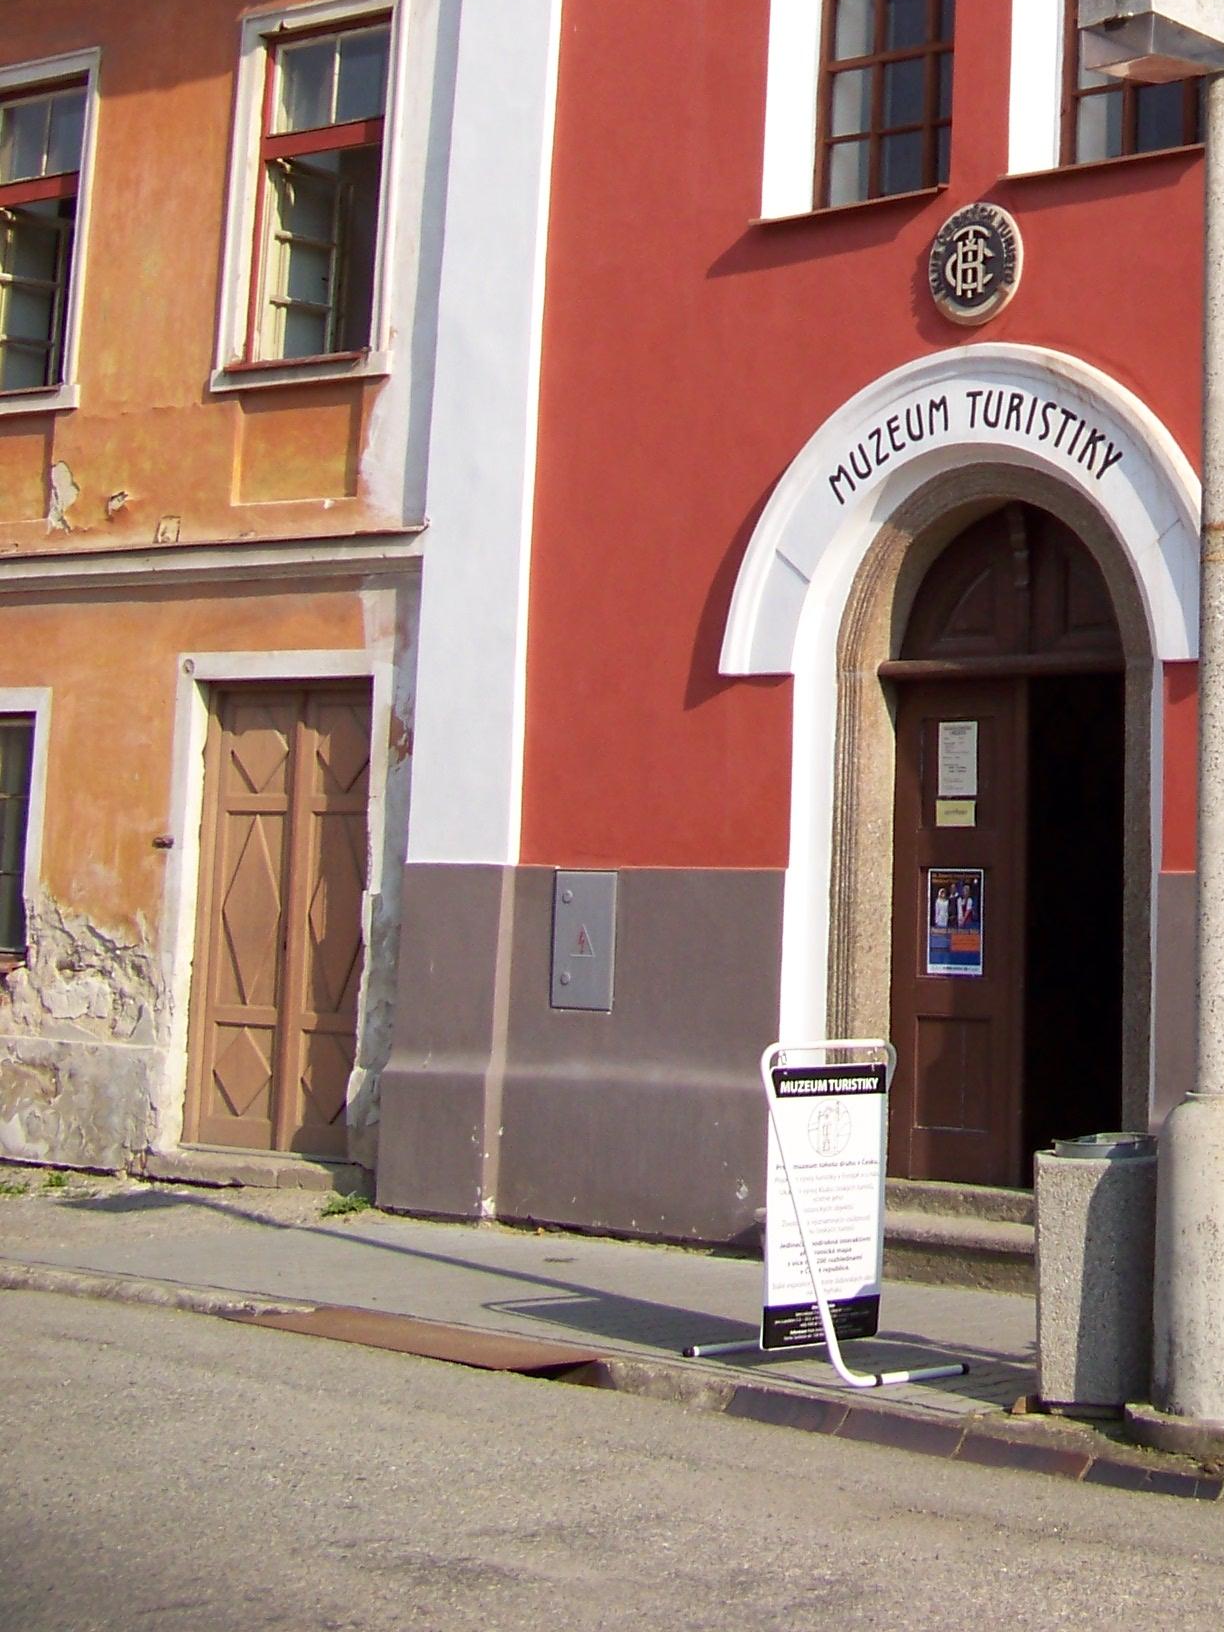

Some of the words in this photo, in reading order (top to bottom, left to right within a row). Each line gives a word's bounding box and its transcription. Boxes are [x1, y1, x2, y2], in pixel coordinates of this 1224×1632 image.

[828, 394, 950, 505] MUZEUM
[965, 389, 1124, 481] TURISTIKY
[780, 1079, 828, 1094] MUZEUM
[828, 1078, 879, 1092] TURISTIKY
